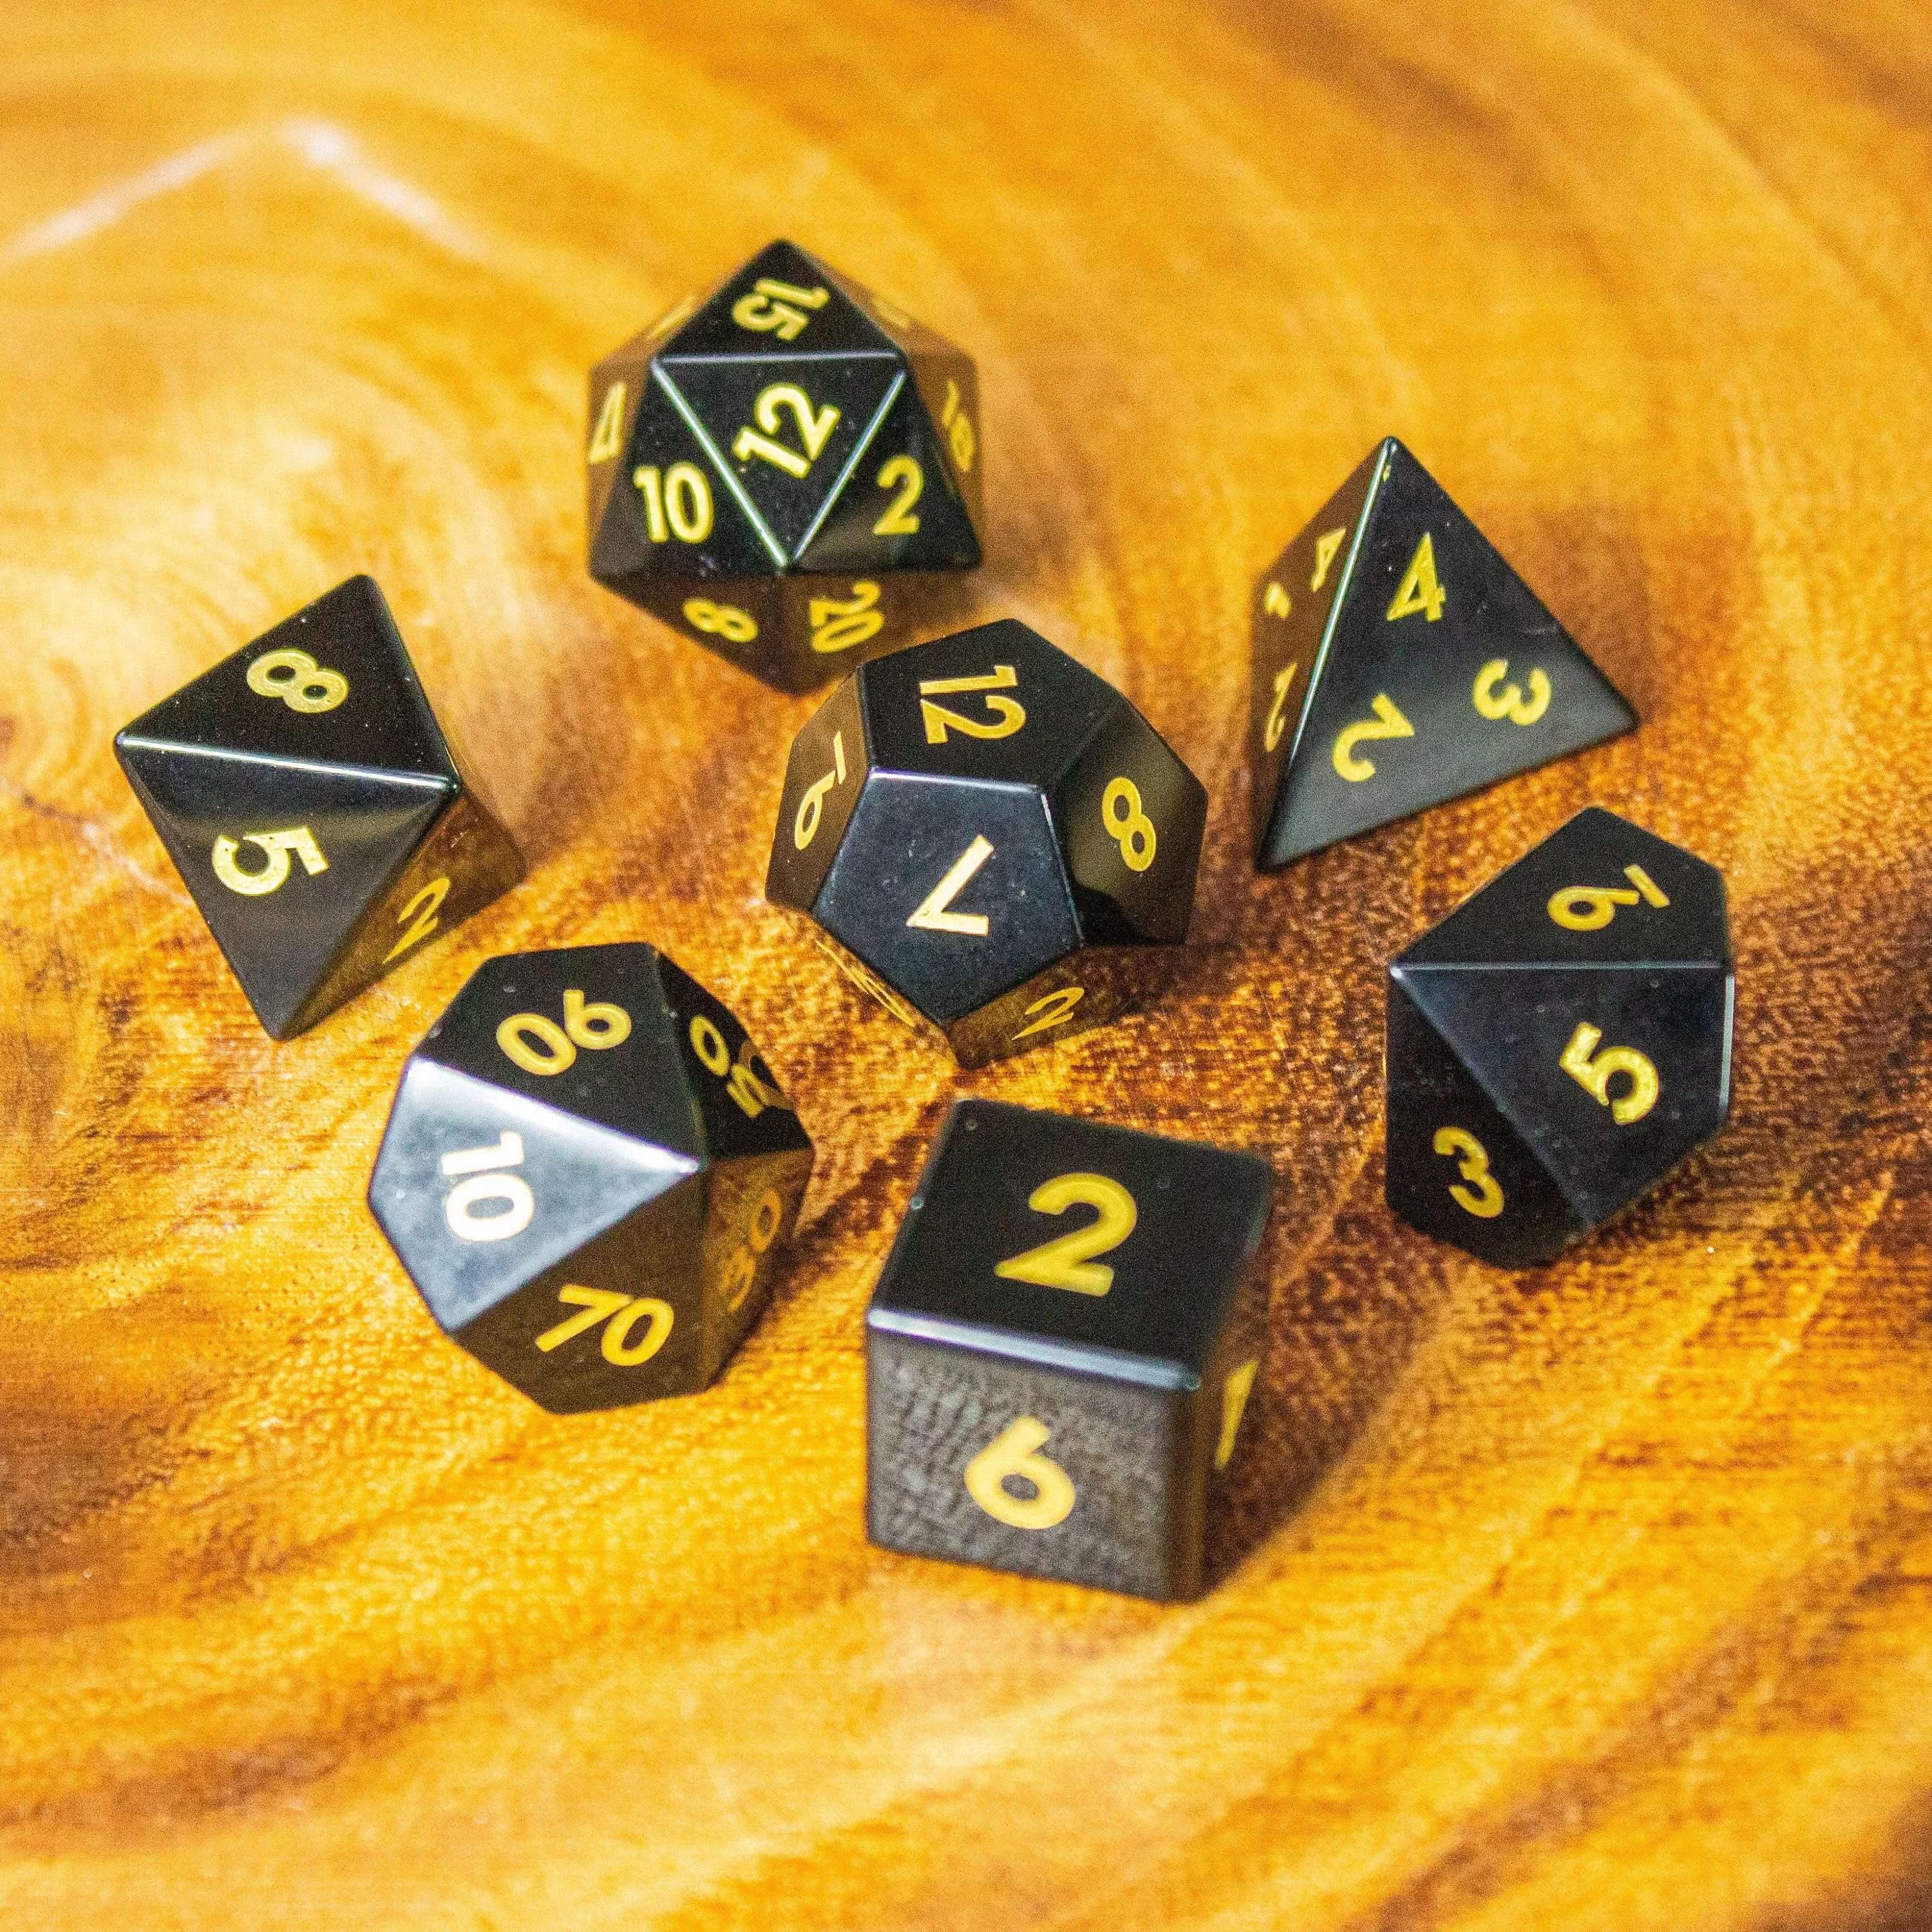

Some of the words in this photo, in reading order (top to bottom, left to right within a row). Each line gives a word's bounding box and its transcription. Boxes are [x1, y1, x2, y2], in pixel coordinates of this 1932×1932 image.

[732, 278, 829, 340] 15
[734, 383, 841, 478] 12
[634, 462, 714, 544] 10
[873, 455, 923, 535] 2
[810, 581, 884, 654] 20
[1387, 532, 1445, 622] 4
[683, 598, 758, 642] 8
[246, 648, 348, 714] 8
[920, 665, 1027, 744] 12
[1473, 659, 1551, 726] 3
[1332, 694, 1414, 782] 2
[212, 826, 329, 896] 5
[1102, 777, 1157, 872] 8
[383, 878, 450, 964] 2
[905, 835, 994, 936] 7
[1012, 987, 1084, 1040] 2
[1559, 1021, 1660, 1125] 5
[441, 1132, 535, 1242] 10
[1434, 1126, 1504, 1219] 3
[994, 1172, 1137, 1297] 2
[535, 1284, 674, 1367] 70
[963, 1417, 1076, 1530] 6
